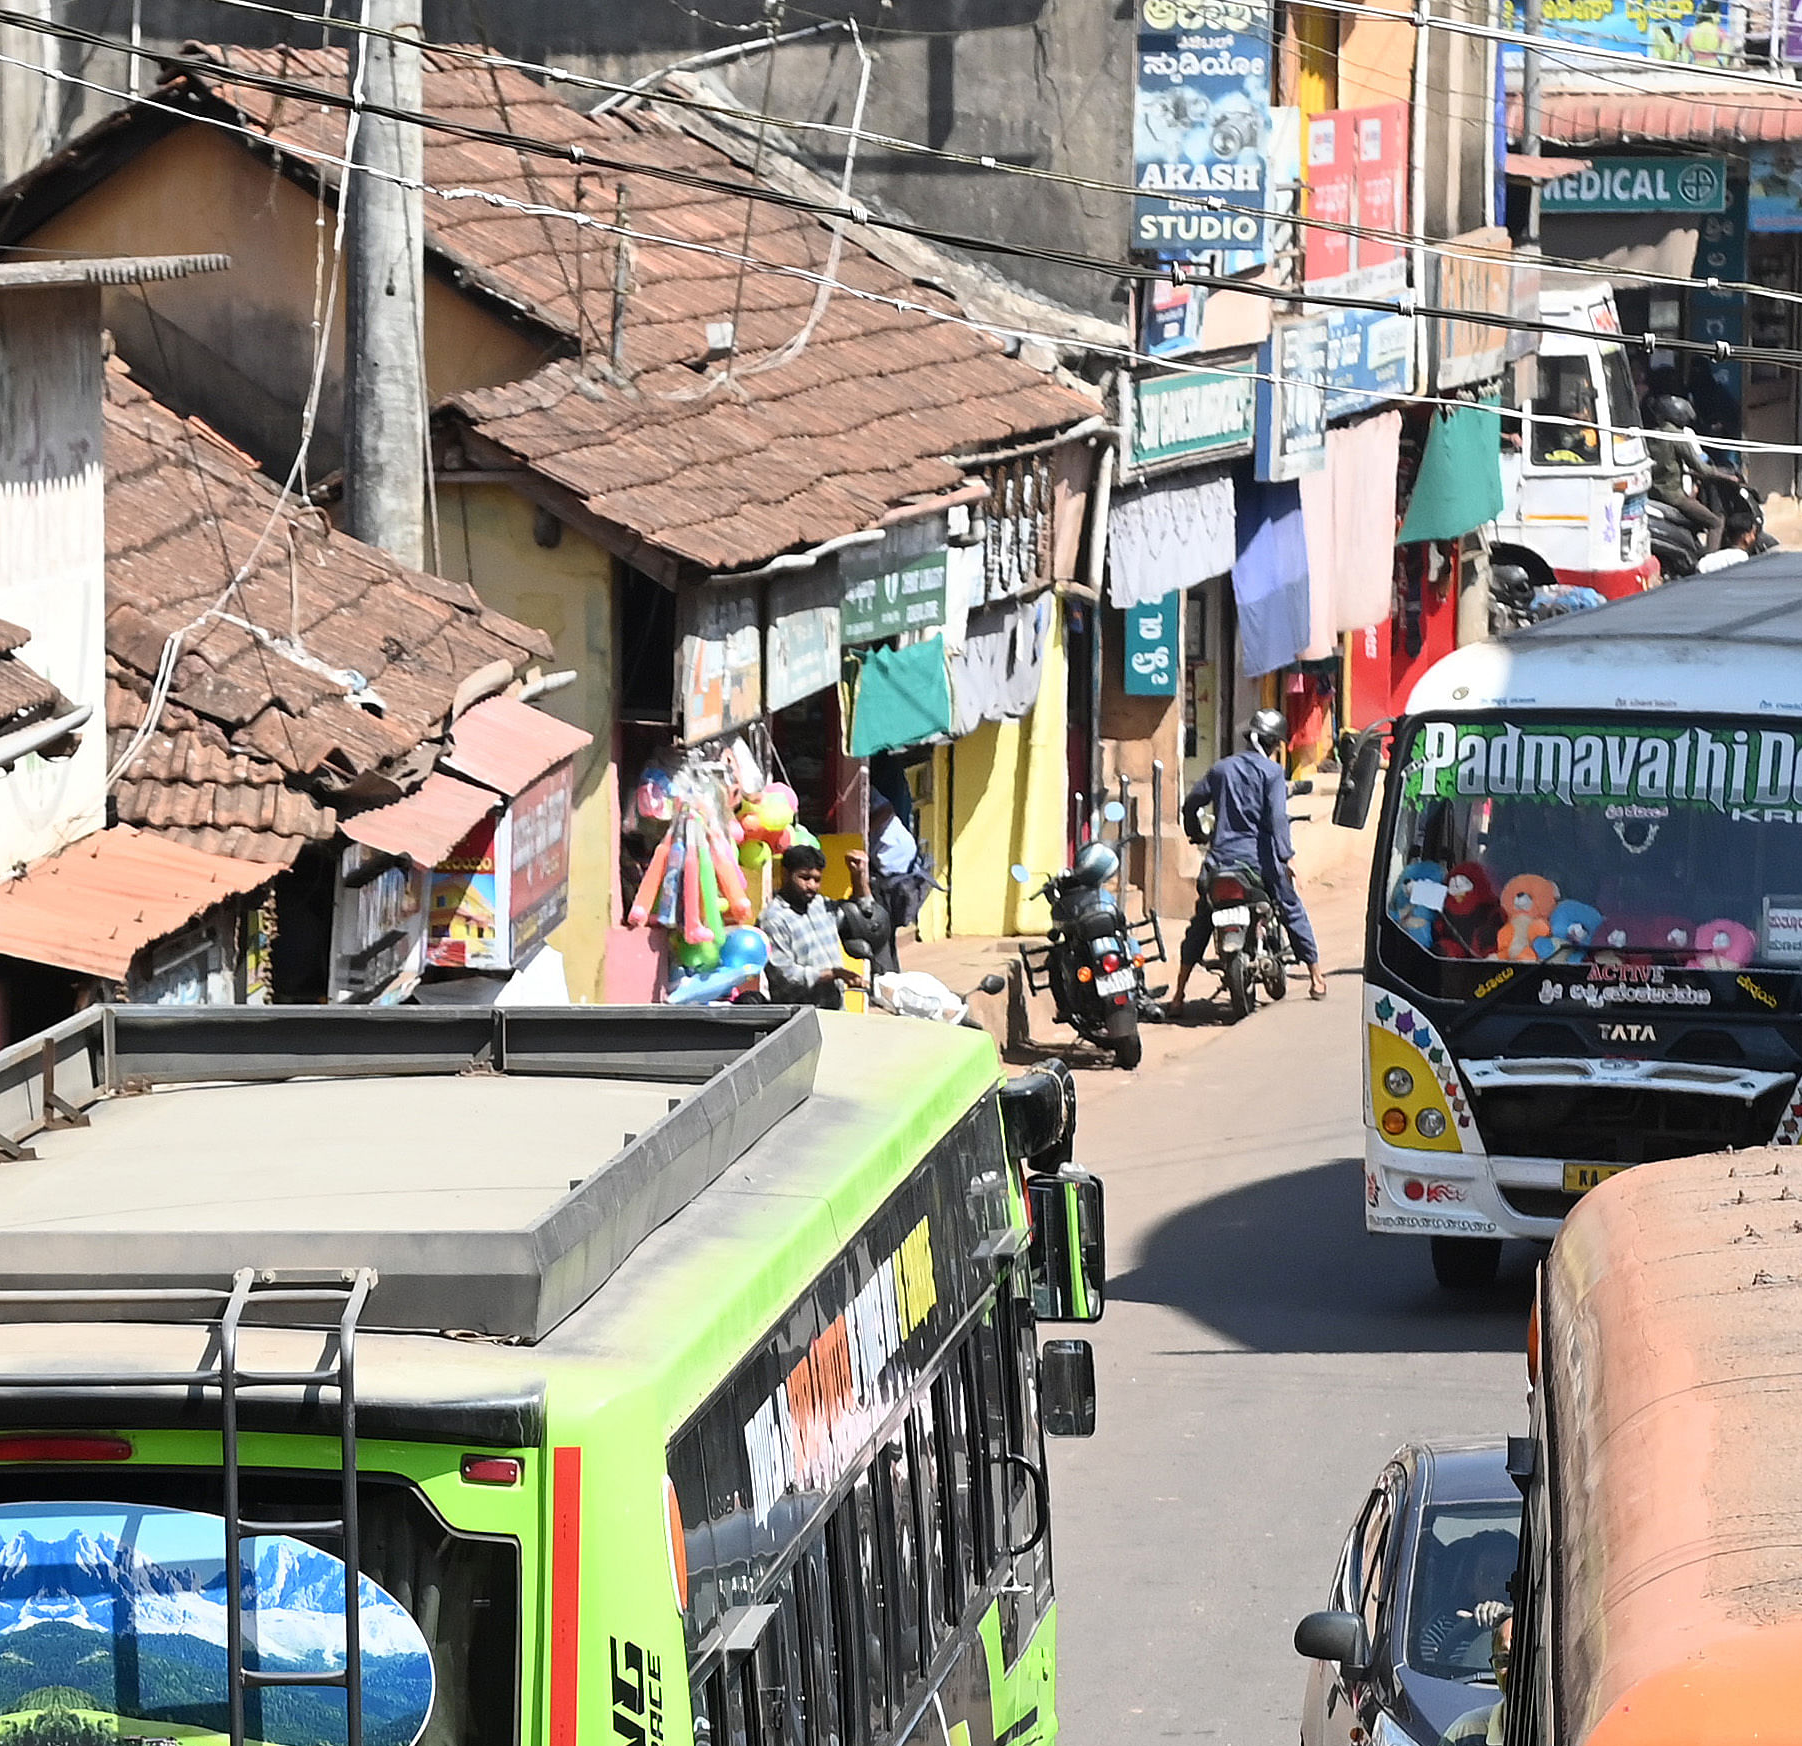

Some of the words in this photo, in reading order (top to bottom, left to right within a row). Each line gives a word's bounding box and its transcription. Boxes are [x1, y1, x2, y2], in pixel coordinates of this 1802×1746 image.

[1139, 163, 1261, 192] AKASH
[1140, 215, 1259, 242] STUDIO
[1586, 963, 1665, 983] ACTIVE
[1597, 1022, 1657, 1042] TATA
